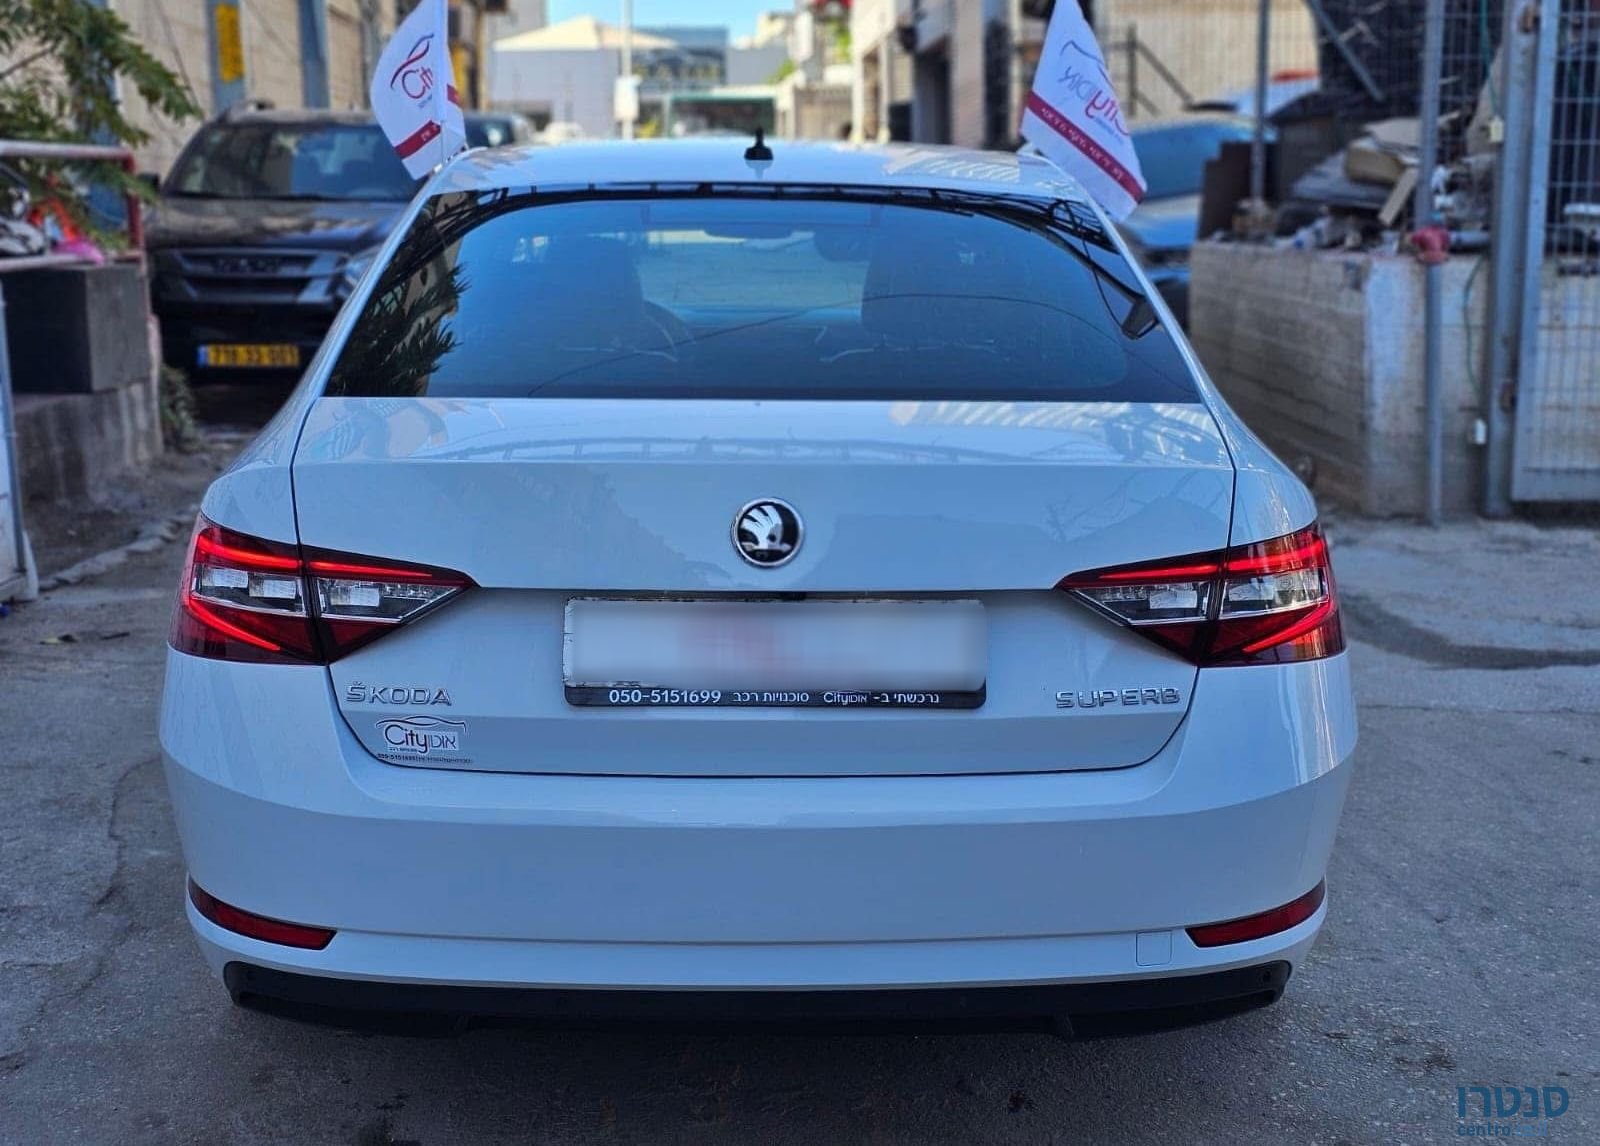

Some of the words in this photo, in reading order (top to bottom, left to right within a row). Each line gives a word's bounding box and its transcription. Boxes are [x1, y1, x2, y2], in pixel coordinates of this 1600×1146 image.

[346, 681, 452, 706] ŠKODA
[608, 689, 721, 703] 050-5151699
[732, 692, 758, 702] רכב
[763, 692, 810, 703] סוכנויות
[893, 692, 940, 704] נרכשתי
[1056, 687, 1180, 708] SUPERB
